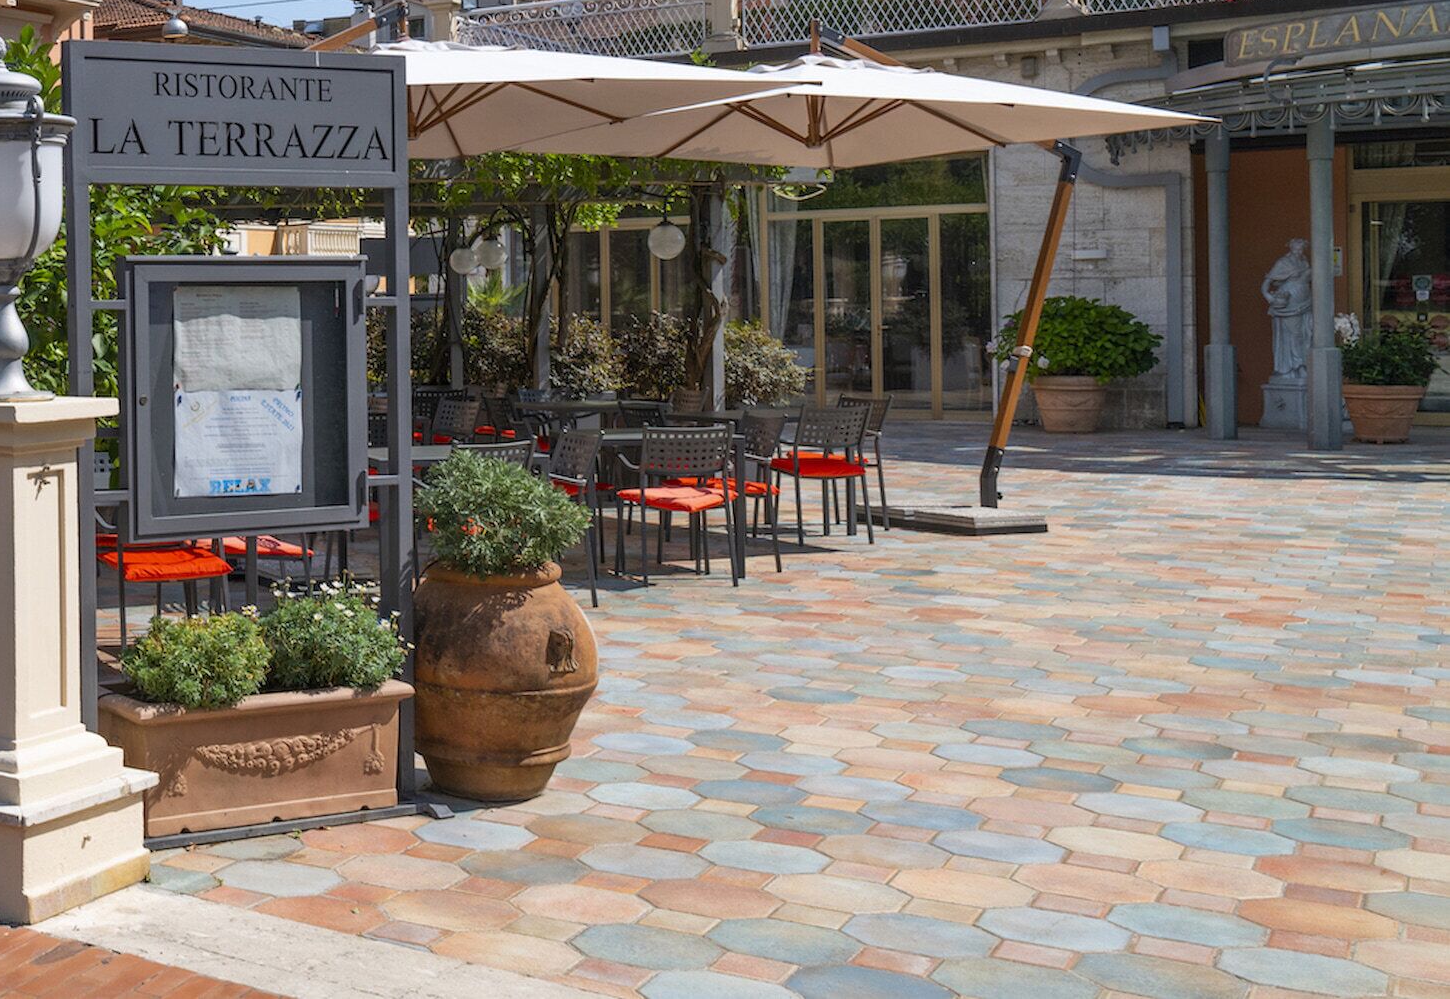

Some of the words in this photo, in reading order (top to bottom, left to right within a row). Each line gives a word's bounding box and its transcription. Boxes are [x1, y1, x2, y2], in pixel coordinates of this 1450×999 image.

[1238, 5, 1450, 59] ESPLANA
[153, 71, 333, 103] RISTORANTE
[89, 117, 150, 156] LA
[168, 119, 390, 161] TERRAZZA
[210, 479, 271, 494] RELAX
